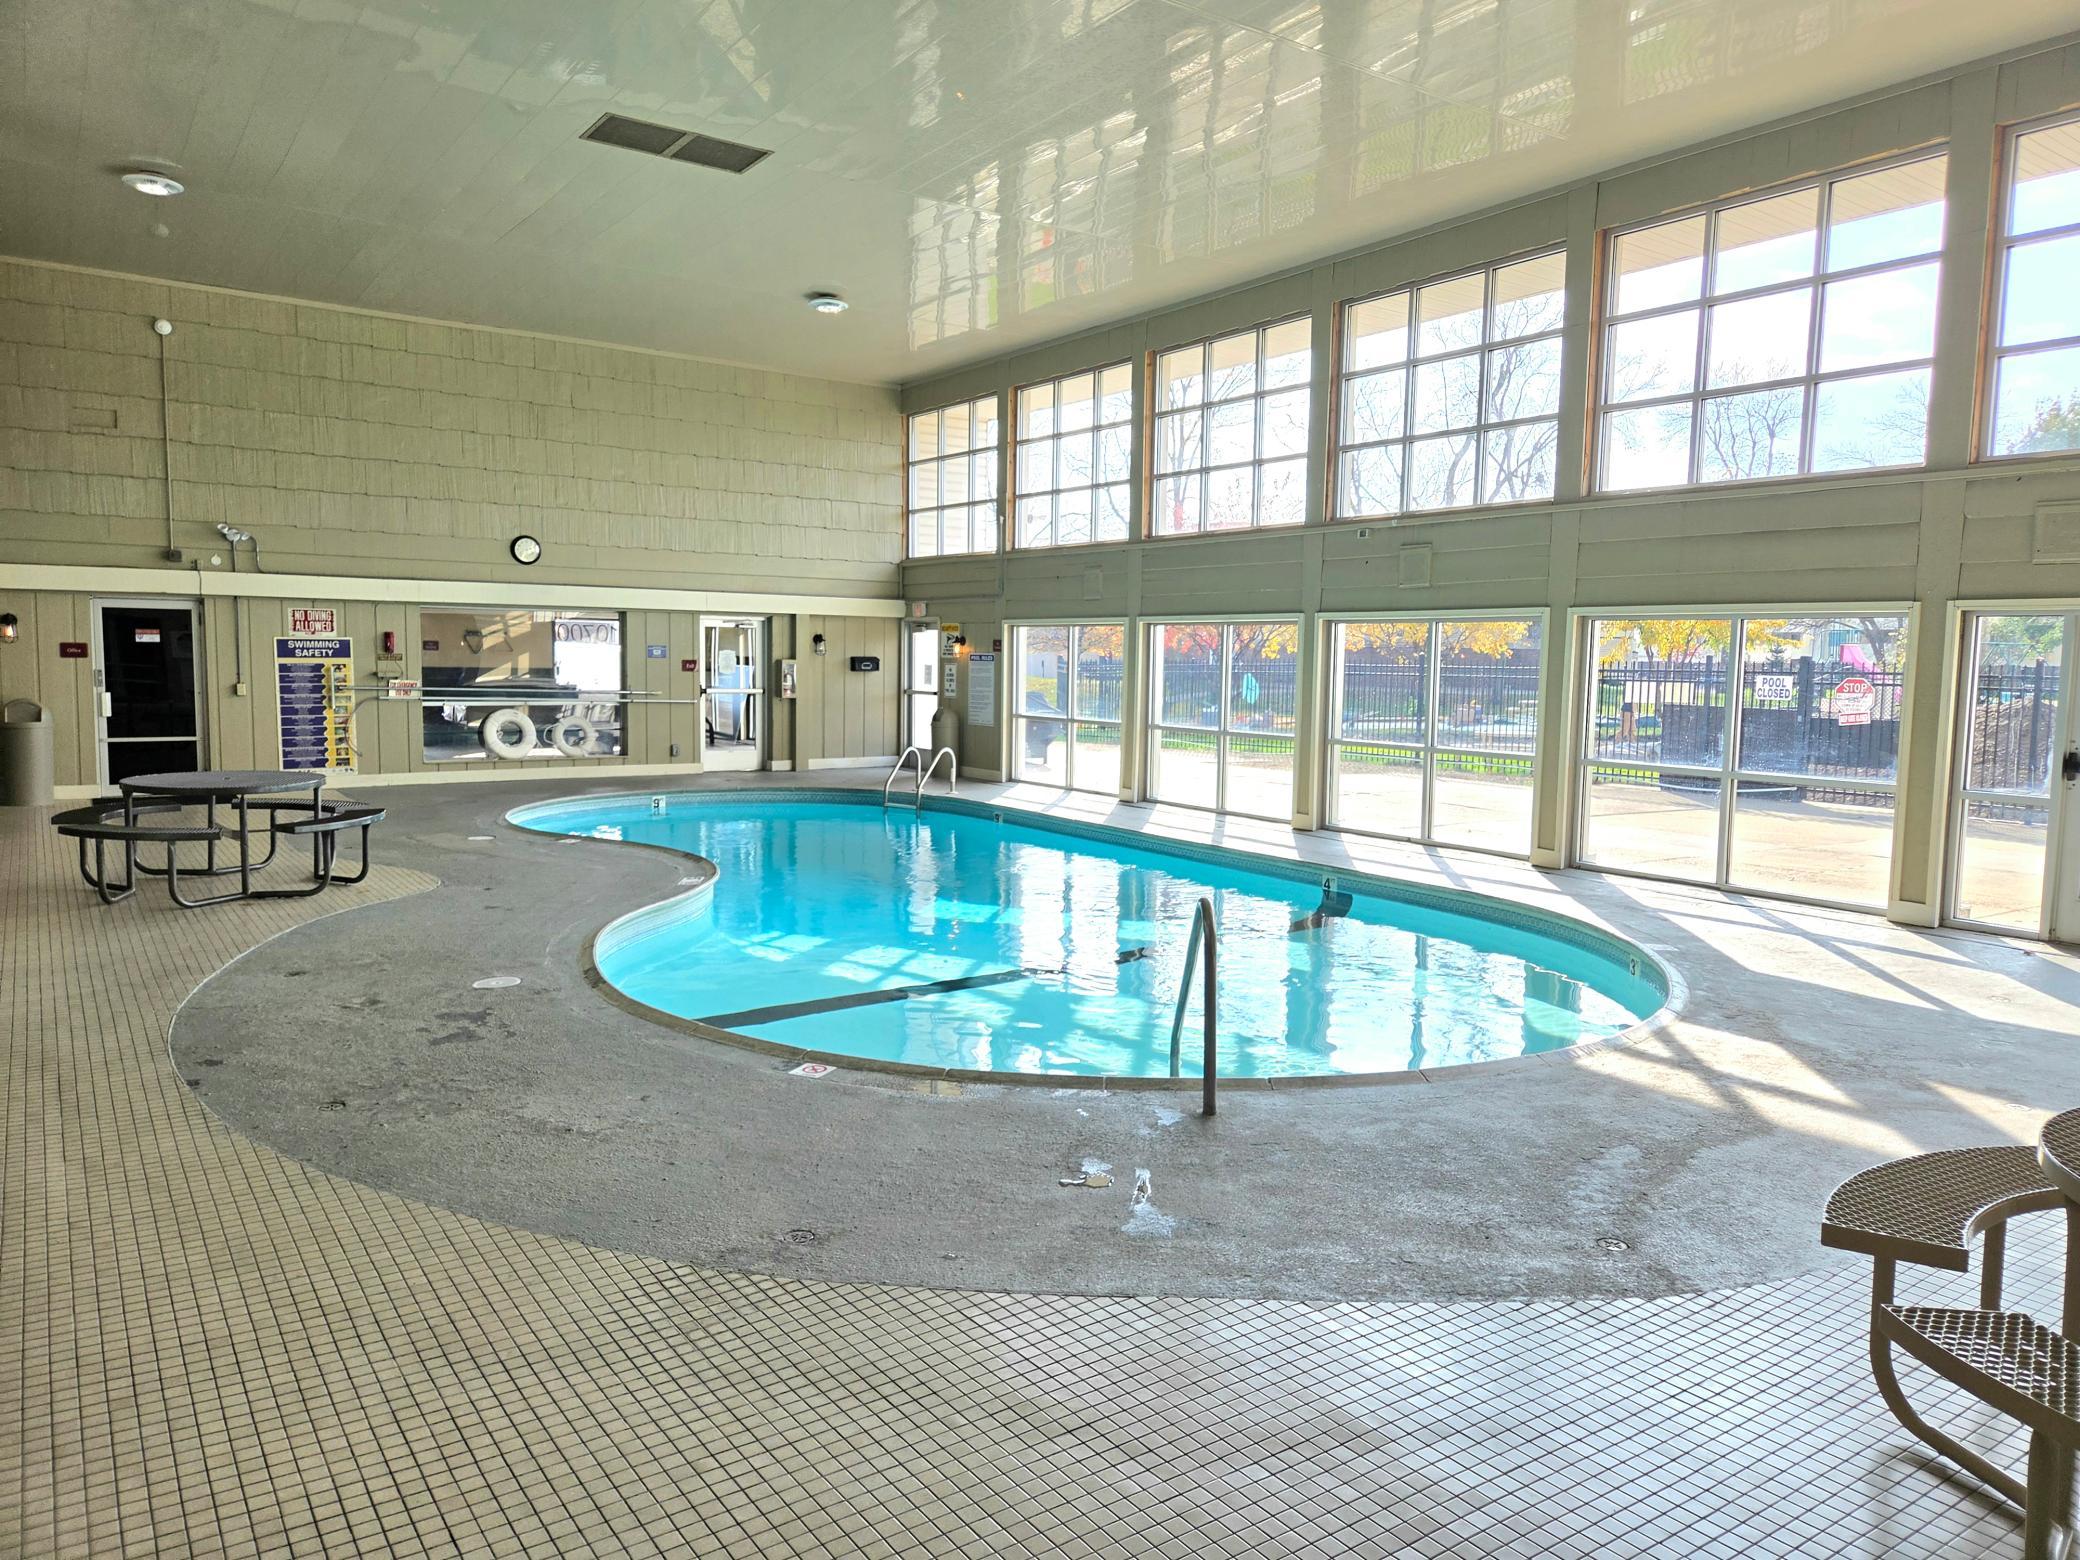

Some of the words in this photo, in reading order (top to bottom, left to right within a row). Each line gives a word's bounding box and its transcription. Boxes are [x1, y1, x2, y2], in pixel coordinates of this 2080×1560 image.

[294, 610, 305, 621] NO
[307, 610, 332, 621] DIVING
[295, 621, 332, 632] ALLOWED
[287, 640, 340, 649] SWIMMING
[295, 649, 334, 657] SAFETY
[1762, 677, 1787, 688] POOL
[1843, 683, 1868, 693] STOP
[1757, 688, 1791, 699] CLOSED
